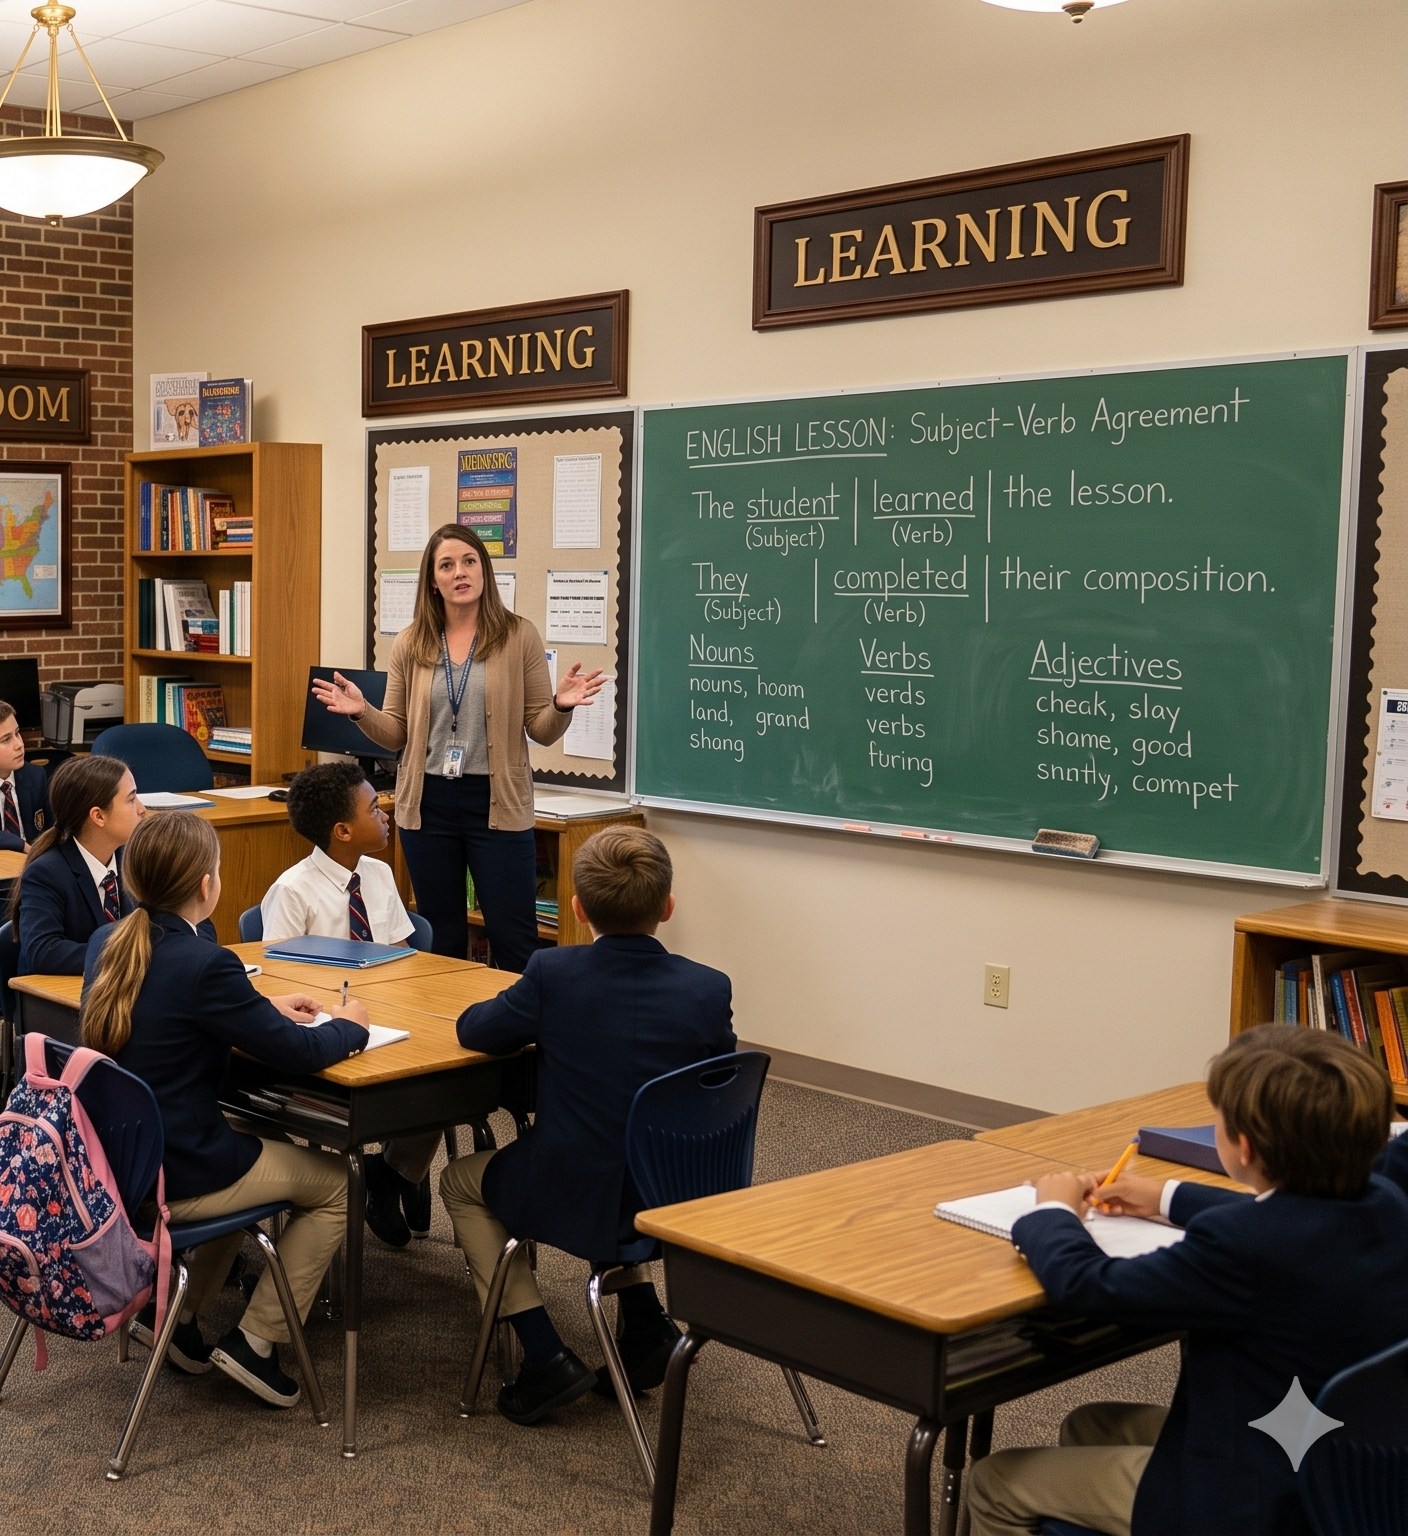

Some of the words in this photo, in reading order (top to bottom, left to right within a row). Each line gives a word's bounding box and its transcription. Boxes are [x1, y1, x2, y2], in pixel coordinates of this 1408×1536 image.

[792, 188, 1133, 288] LEARNING
[385, 324, 597, 389] LEARNING
[686, 424, 782, 461] ENGLISH
[795, 416, 894, 452] LESSON:
[910, 402, 1077, 455] Subject-Verb
[1090, 386, 1250, 446] Agreement
[691, 490, 735, 519] The
[747, 482, 841, 517] student
[873, 475, 974, 513] learned
[1003, 473, 1052, 508] the
[1070, 469, 1174, 506] lesson.
[744, 523, 825, 557] (Subject)
[892, 519, 953, 547] (Verb)
[692, 561, 749, 601] They
[833, 554, 967, 601] completed
[999, 556, 1071, 591] their
[1083, 556, 1276, 604] composition.
[703, 597, 782, 630] (Subject)
[864, 596, 926, 627] (Verb)
[690, 633, 755, 663] Nouns
[859, 638, 931, 670] Verbs
[1030, 639, 1182, 688] Adjectives
[690, 677, 749, 699] nouns,
[757, 674, 805, 699] hoom
[864, 680, 926, 706] verds
[691, 699, 735, 727] land,
[755, 706, 811, 736] grand
[866, 713, 927, 739] verbs
[1128, 693, 1181, 734] slay
[690, 727, 744, 763] shang
[1037, 721, 1119, 756] shame,
[1132, 729, 1192, 766] good
[868, 740, 934, 788] furing
